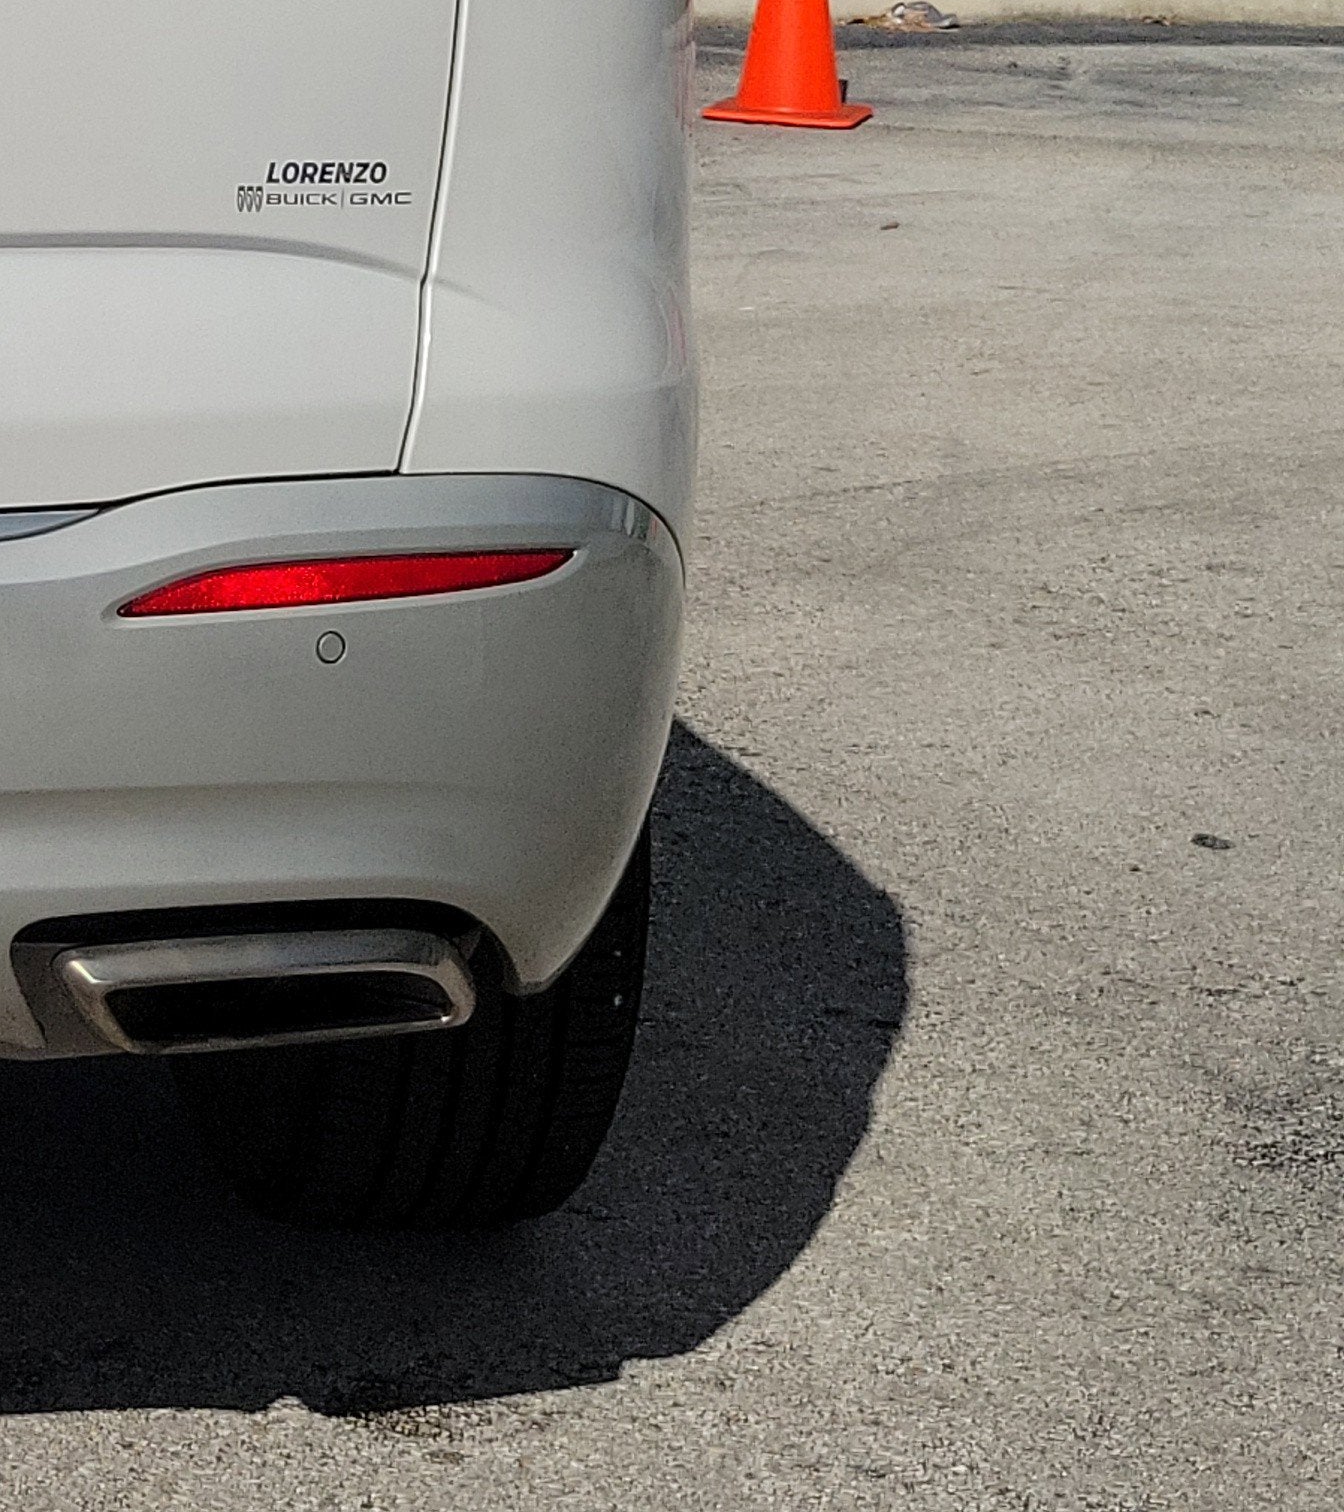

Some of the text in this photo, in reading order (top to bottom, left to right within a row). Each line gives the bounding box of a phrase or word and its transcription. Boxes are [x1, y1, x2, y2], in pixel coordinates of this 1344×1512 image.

[265, 161, 388, 184] LORENZO
[265, 191, 413, 206] BUICK GMC
